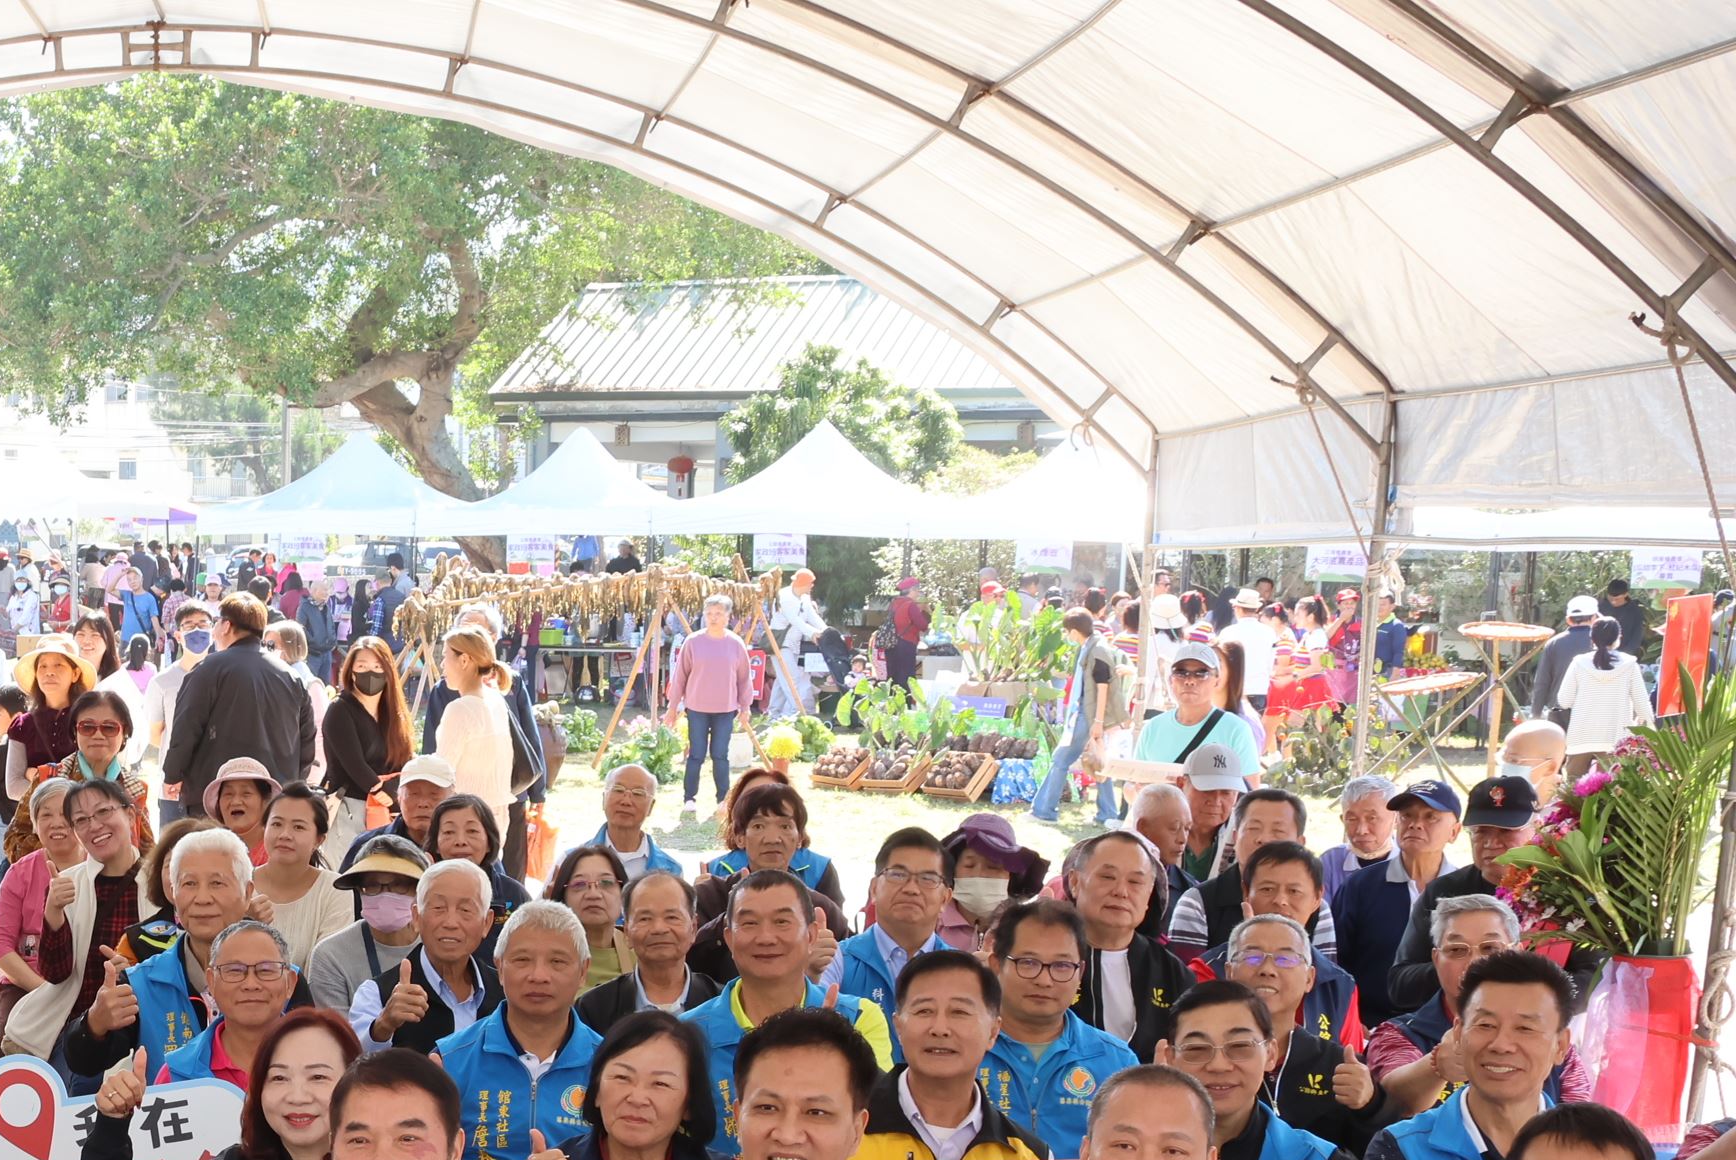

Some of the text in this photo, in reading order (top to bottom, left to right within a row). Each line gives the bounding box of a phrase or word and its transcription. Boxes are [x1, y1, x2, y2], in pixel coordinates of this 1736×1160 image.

[495, 1089, 512, 1149] 館東社區
[997, 1070, 1013, 1117] 福星社
